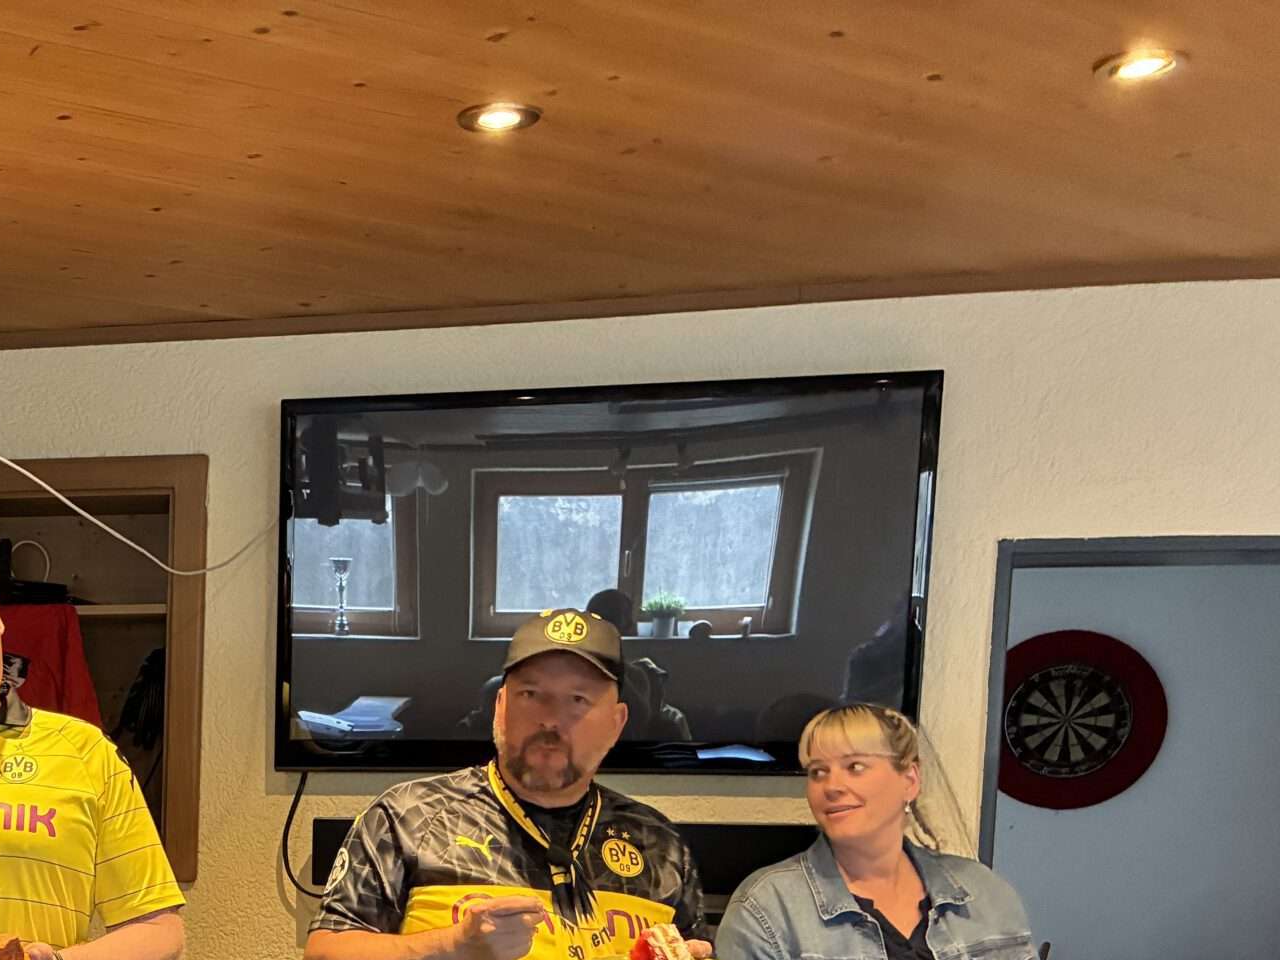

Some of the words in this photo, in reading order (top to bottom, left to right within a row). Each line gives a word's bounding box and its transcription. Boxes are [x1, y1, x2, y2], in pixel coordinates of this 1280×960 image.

[552, 613, 584, 636] BVB
[4, 756, 34, 773] BVB
[609, 842, 639, 866] BVB
